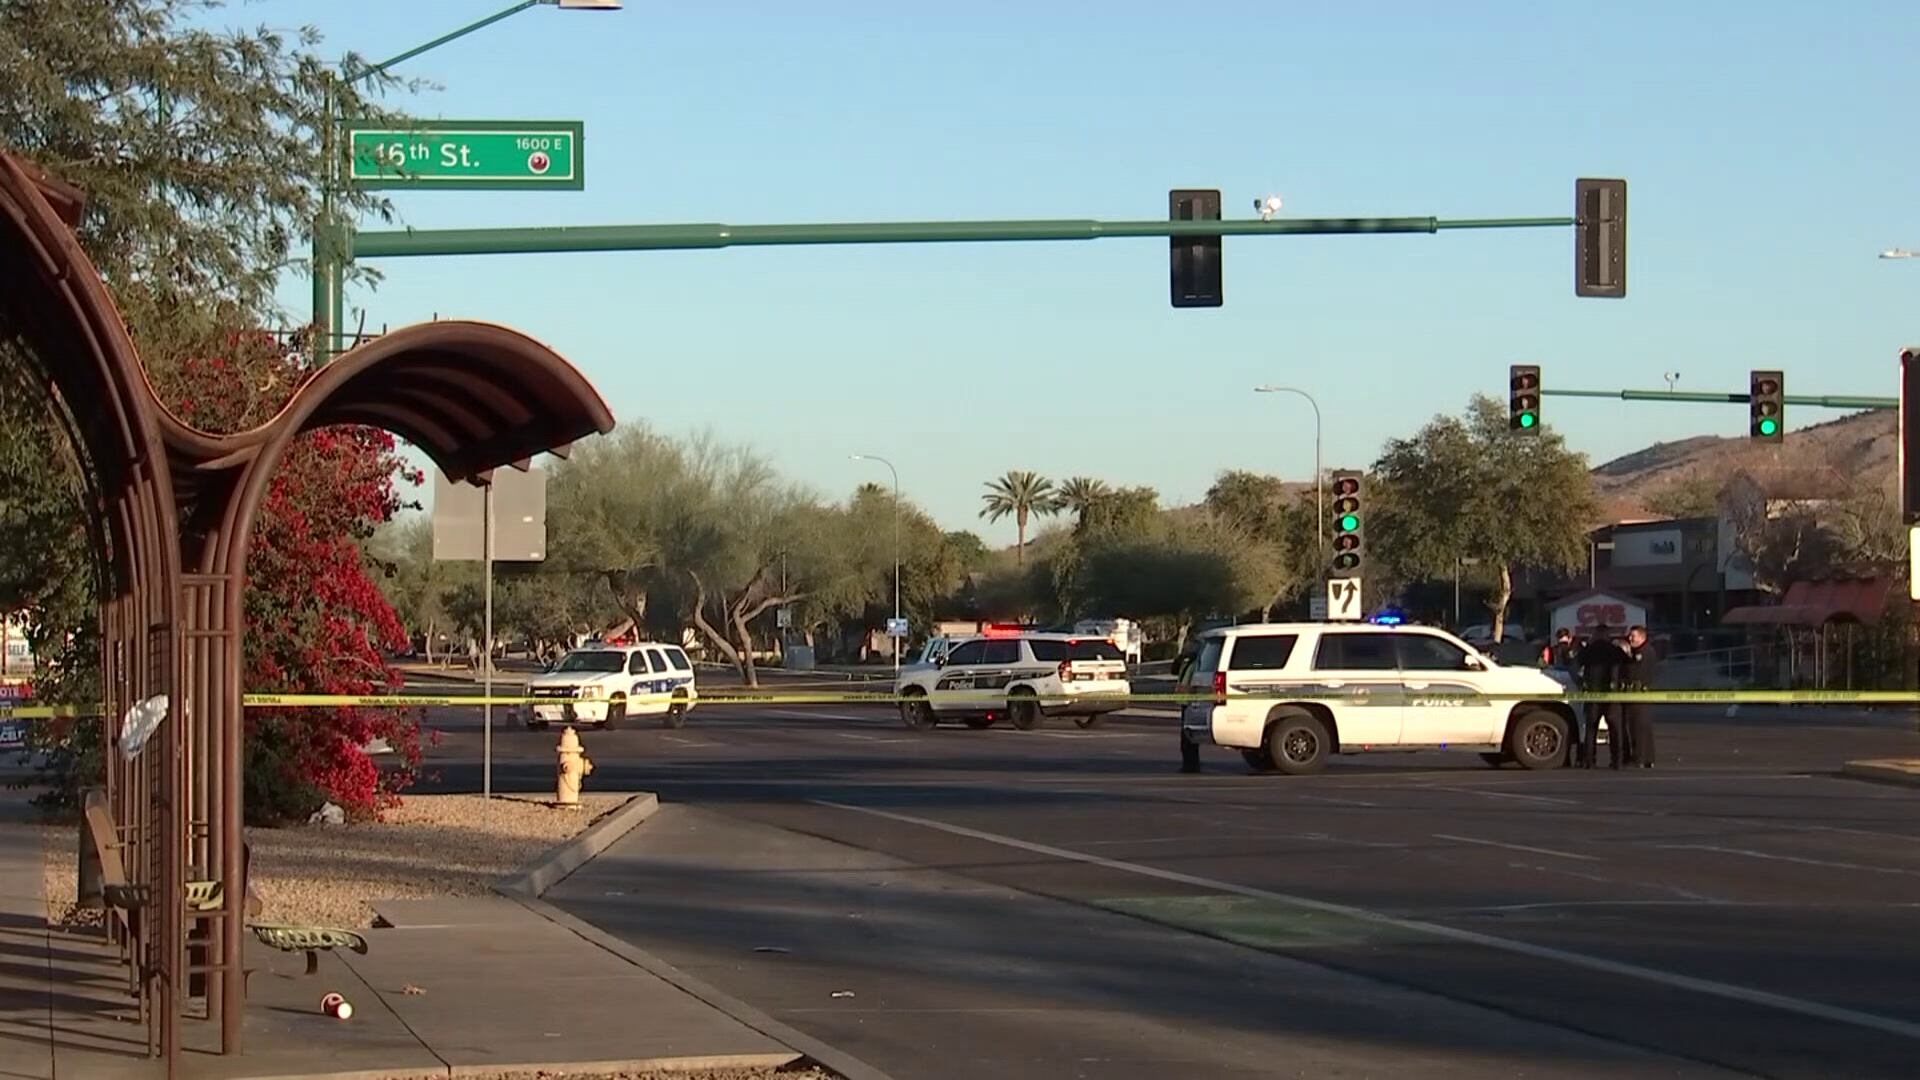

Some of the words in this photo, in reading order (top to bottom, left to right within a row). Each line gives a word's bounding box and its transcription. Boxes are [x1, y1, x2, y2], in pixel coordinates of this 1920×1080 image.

[515, 138, 550, 150] 1600
[554, 138, 562, 150] E
[374, 142, 430, 167] 16th
[440, 143, 480, 168] St.
[1576, 604, 1626, 624] CVS
